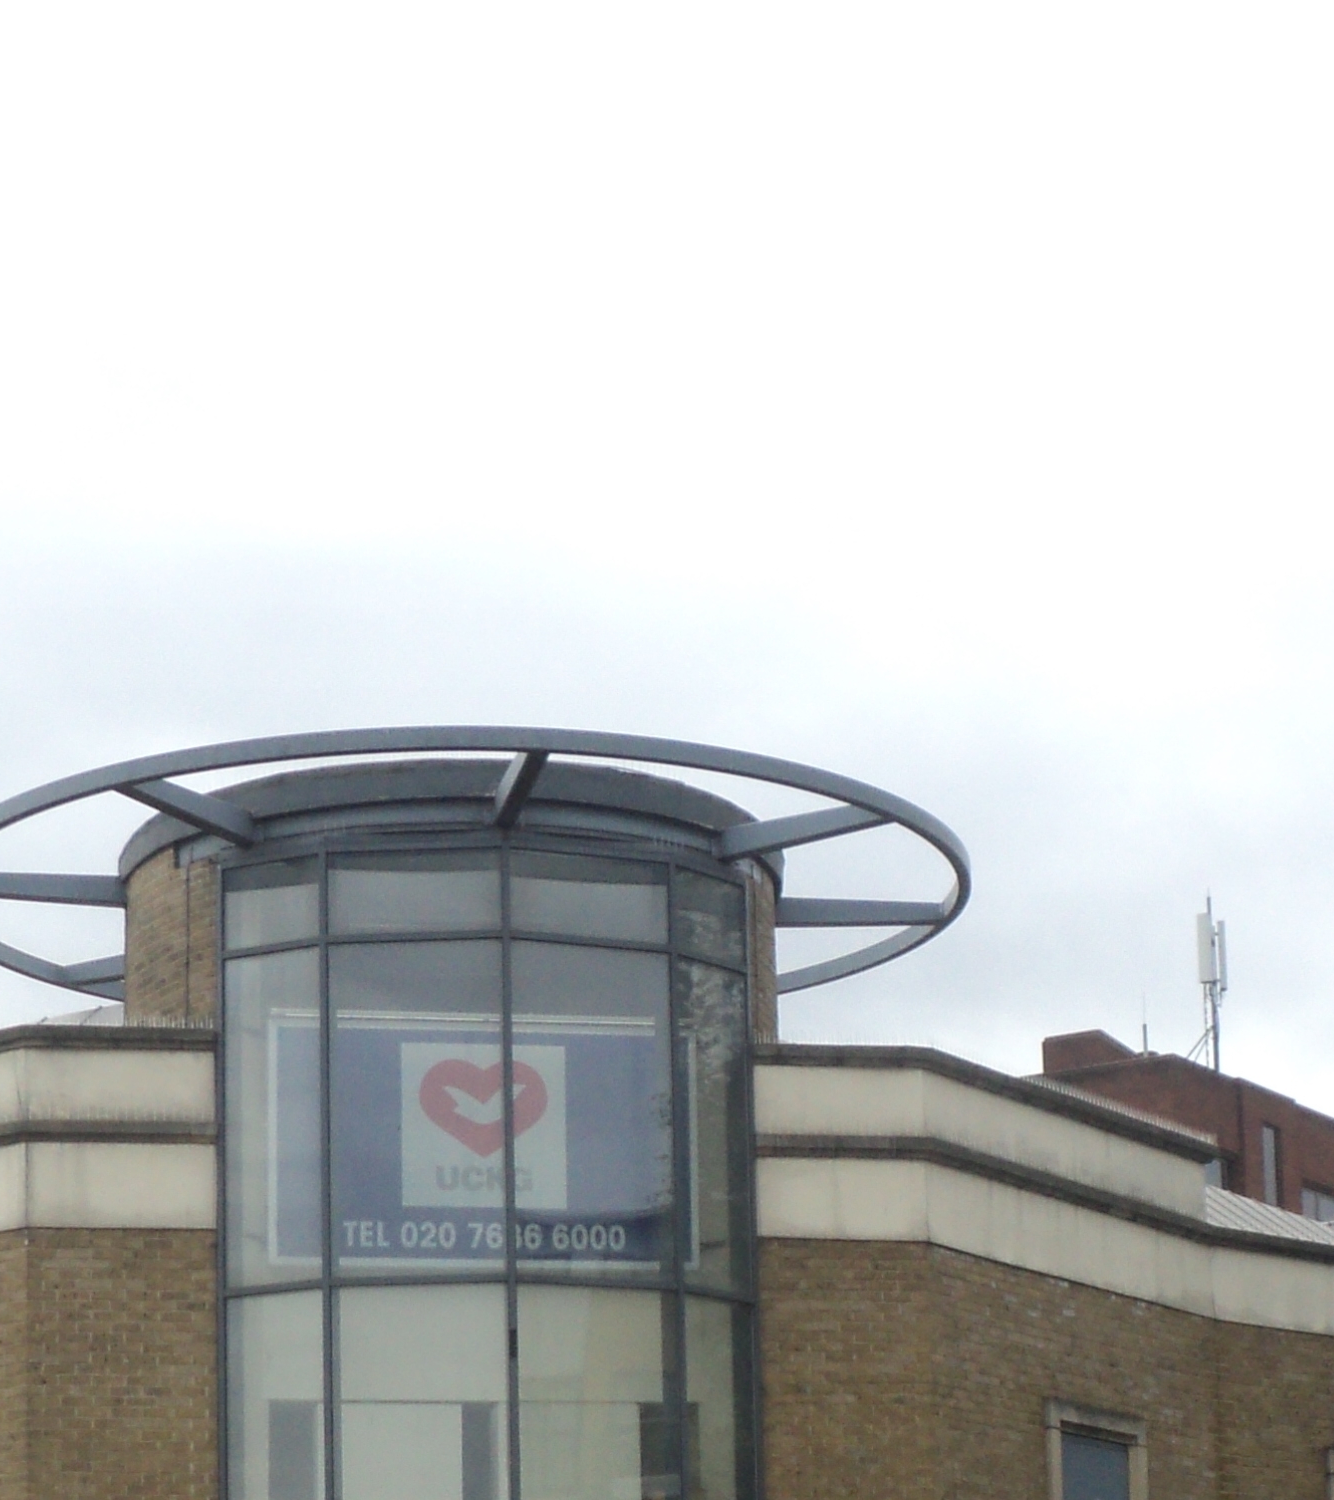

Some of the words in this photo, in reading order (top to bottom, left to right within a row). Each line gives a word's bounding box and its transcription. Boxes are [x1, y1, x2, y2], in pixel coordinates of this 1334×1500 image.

[343, 1220, 390, 1248] TEL
[400, 1221, 457, 1250] 020
[552, 1224, 626, 1251] 6000
